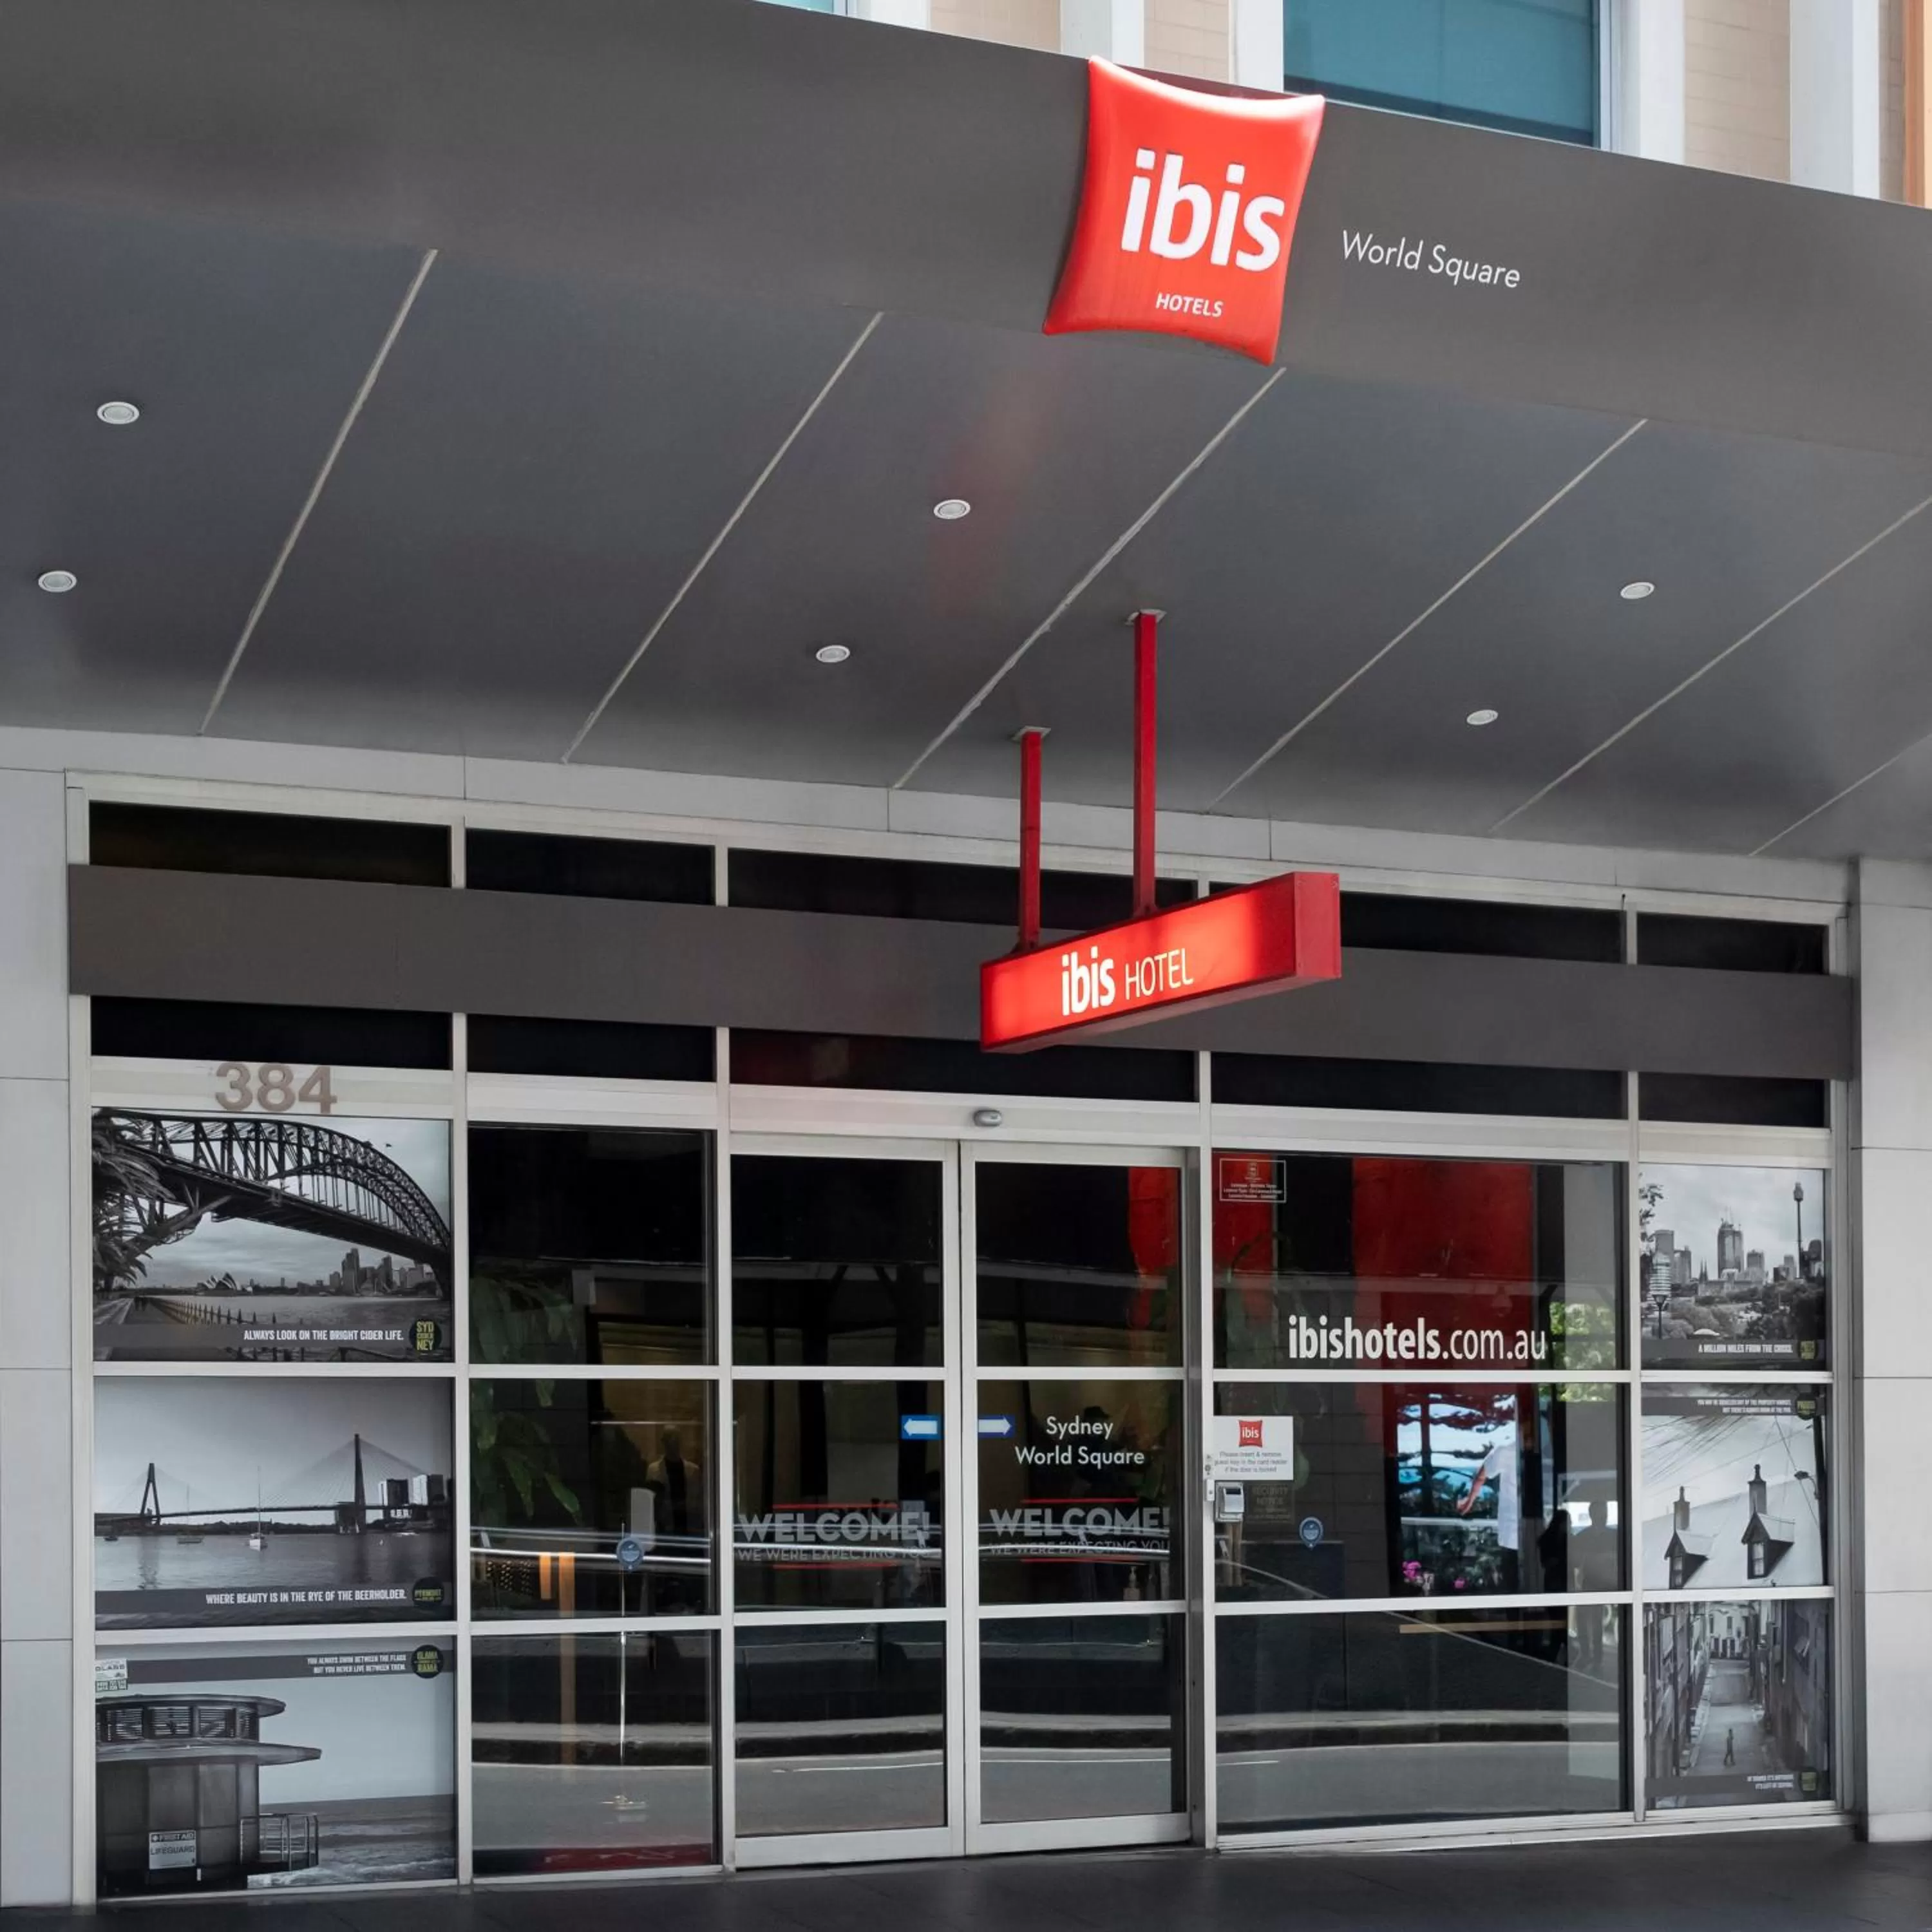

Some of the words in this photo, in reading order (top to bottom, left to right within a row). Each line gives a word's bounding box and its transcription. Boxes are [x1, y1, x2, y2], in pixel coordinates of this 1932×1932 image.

[1121, 147, 1285, 272] ibis
[1343, 229, 1424, 271] World
[1428, 244, 1520, 288] Square
[1155, 292, 1224, 318] HOTELS
[1061, 946, 1115, 1016] ibis
[1125, 947, 1194, 1000] HOTEL
[214, 1063, 337, 1115] 384
[244, 1330, 275, 1340] ALWAYS
[276, 1330, 297, 1340] LOOK
[298, 1330, 310, 1340] ON
[312, 1330, 328, 1340] THE
[329, 1330, 359, 1340] BRIGHT
[360, 1330, 384, 1340] CIDER
[385, 1330, 404, 1340] LIFE.
[417, 1321, 433, 1332] SYD
[1289, 1314, 1546, 1359] ibishotels.com.au
[417, 1339, 433, 1350] NEY
[1046, 1415, 1113, 1440] Sydney
[1242, 1426, 1260, 1439] ibis
[1014, 1444, 1072, 1464] World
[1077, 1446, 1145, 1470] Square
[741, 1511, 930, 1542] WELCOME!
[989, 1507, 1170, 1537] WELCOME!
[739, 1548, 761, 1561] WE
[766, 1548, 807, 1561] WERE
[205, 1593, 235, 1604] WHERE
[236, 1592, 268, 1603] BEAUTY
[269, 1592, 279, 1603] IS
[280, 1591, 289, 1602] IN
[290, 1591, 307, 1602] THE
[308, 1591, 324, 1602] RYE
[325, 1591, 336, 1602] OF
[337, 1591, 354, 1601] THE
[355, 1589, 407, 1600] BEERHOLDER.
[365, 1664, 390, 1672] BETWEEN
